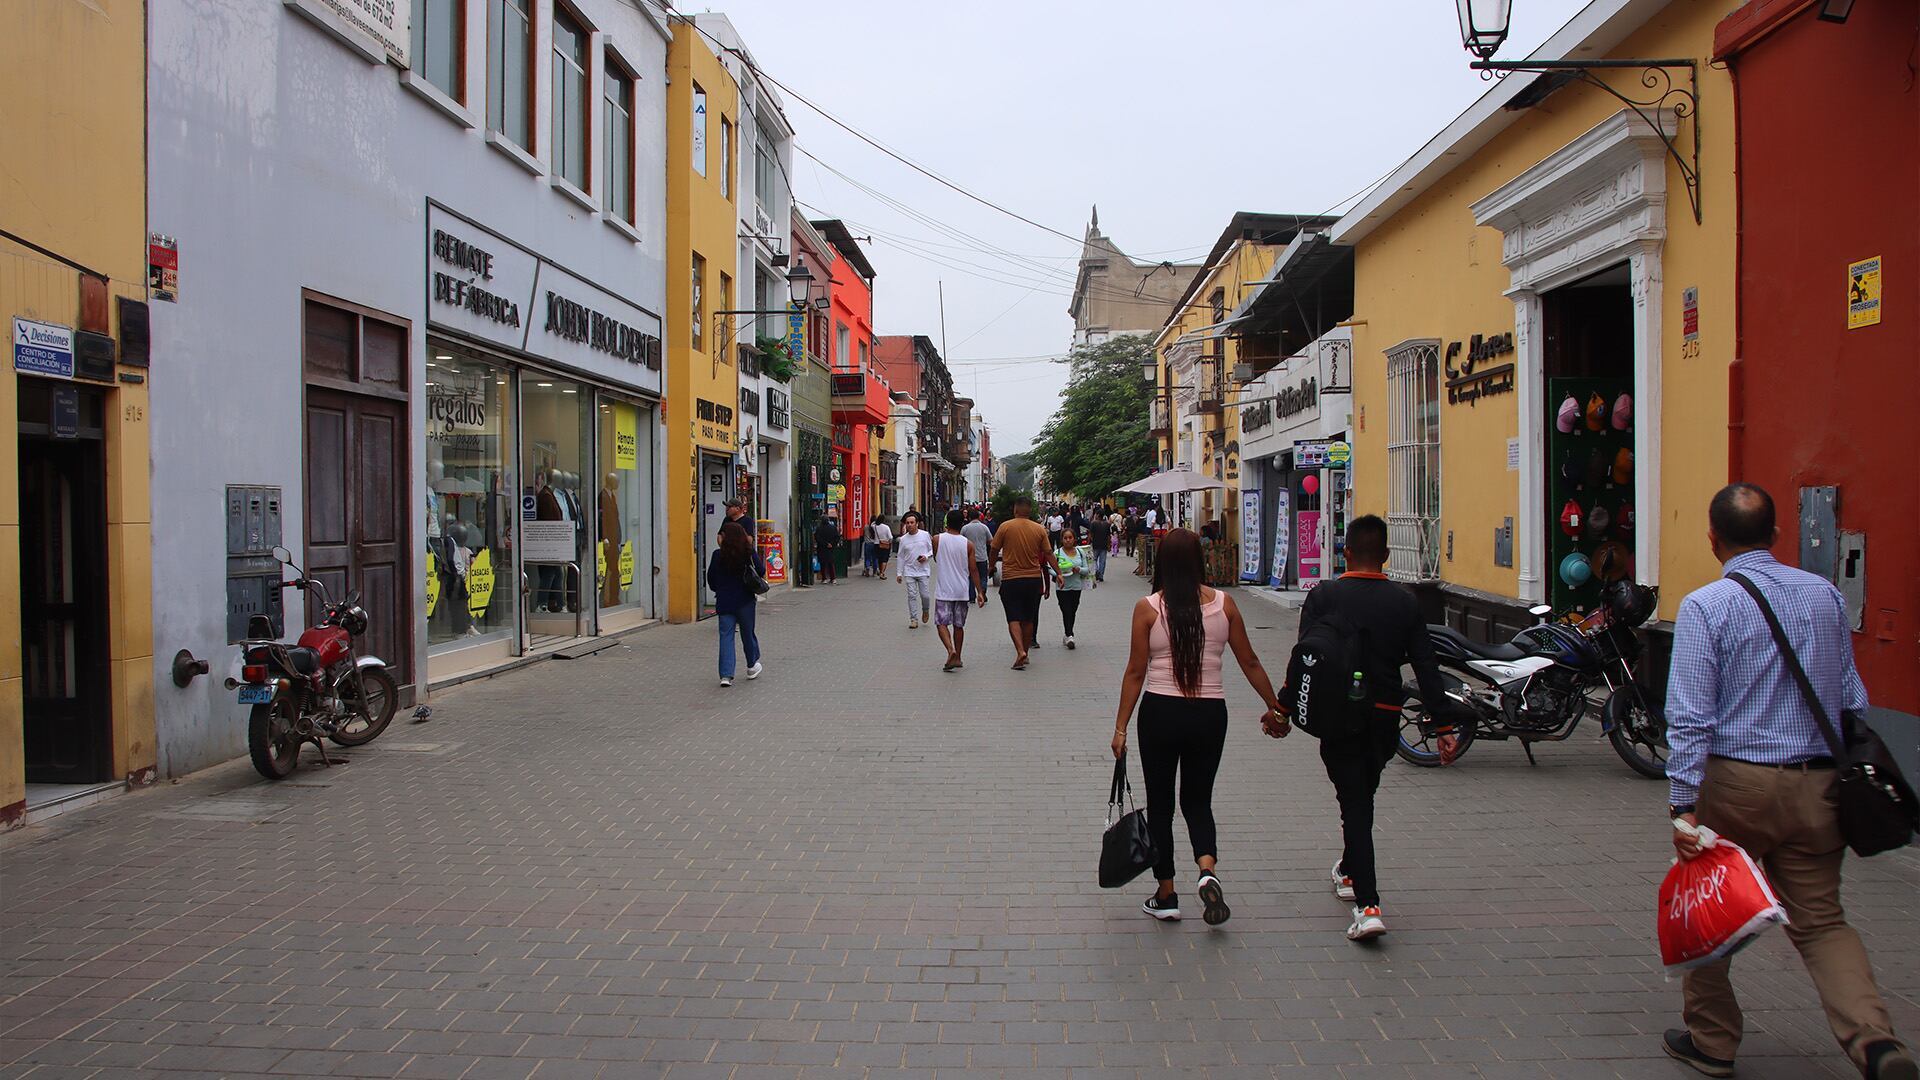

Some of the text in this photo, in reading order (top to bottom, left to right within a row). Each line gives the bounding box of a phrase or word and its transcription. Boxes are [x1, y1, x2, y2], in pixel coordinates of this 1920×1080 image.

[434, 229, 494, 281] REMATE
[1851, 299, 1878, 313] PROSEGUR
[31, 328, 69, 346] Decisiones
[545, 290, 647, 366] JOHN HOLDEN
[21, 347, 57, 361] CENTRO DE
[1321, 341, 1349, 351] CENTRO DE
[1331, 346, 1339, 387] MASAJES
[429, 391, 485, 433] regalos
[715, 403, 733, 427] STEP
[429, 431, 449, 442] PARA
[702, 425, 729, 444] PASO FIRME
[1300, 519, 1309, 554] LIPOLAX
[471, 567, 490, 577] CASACAS
[471, 582, 490, 594] S/29.90
[1297, 673, 1311, 726] adidas
